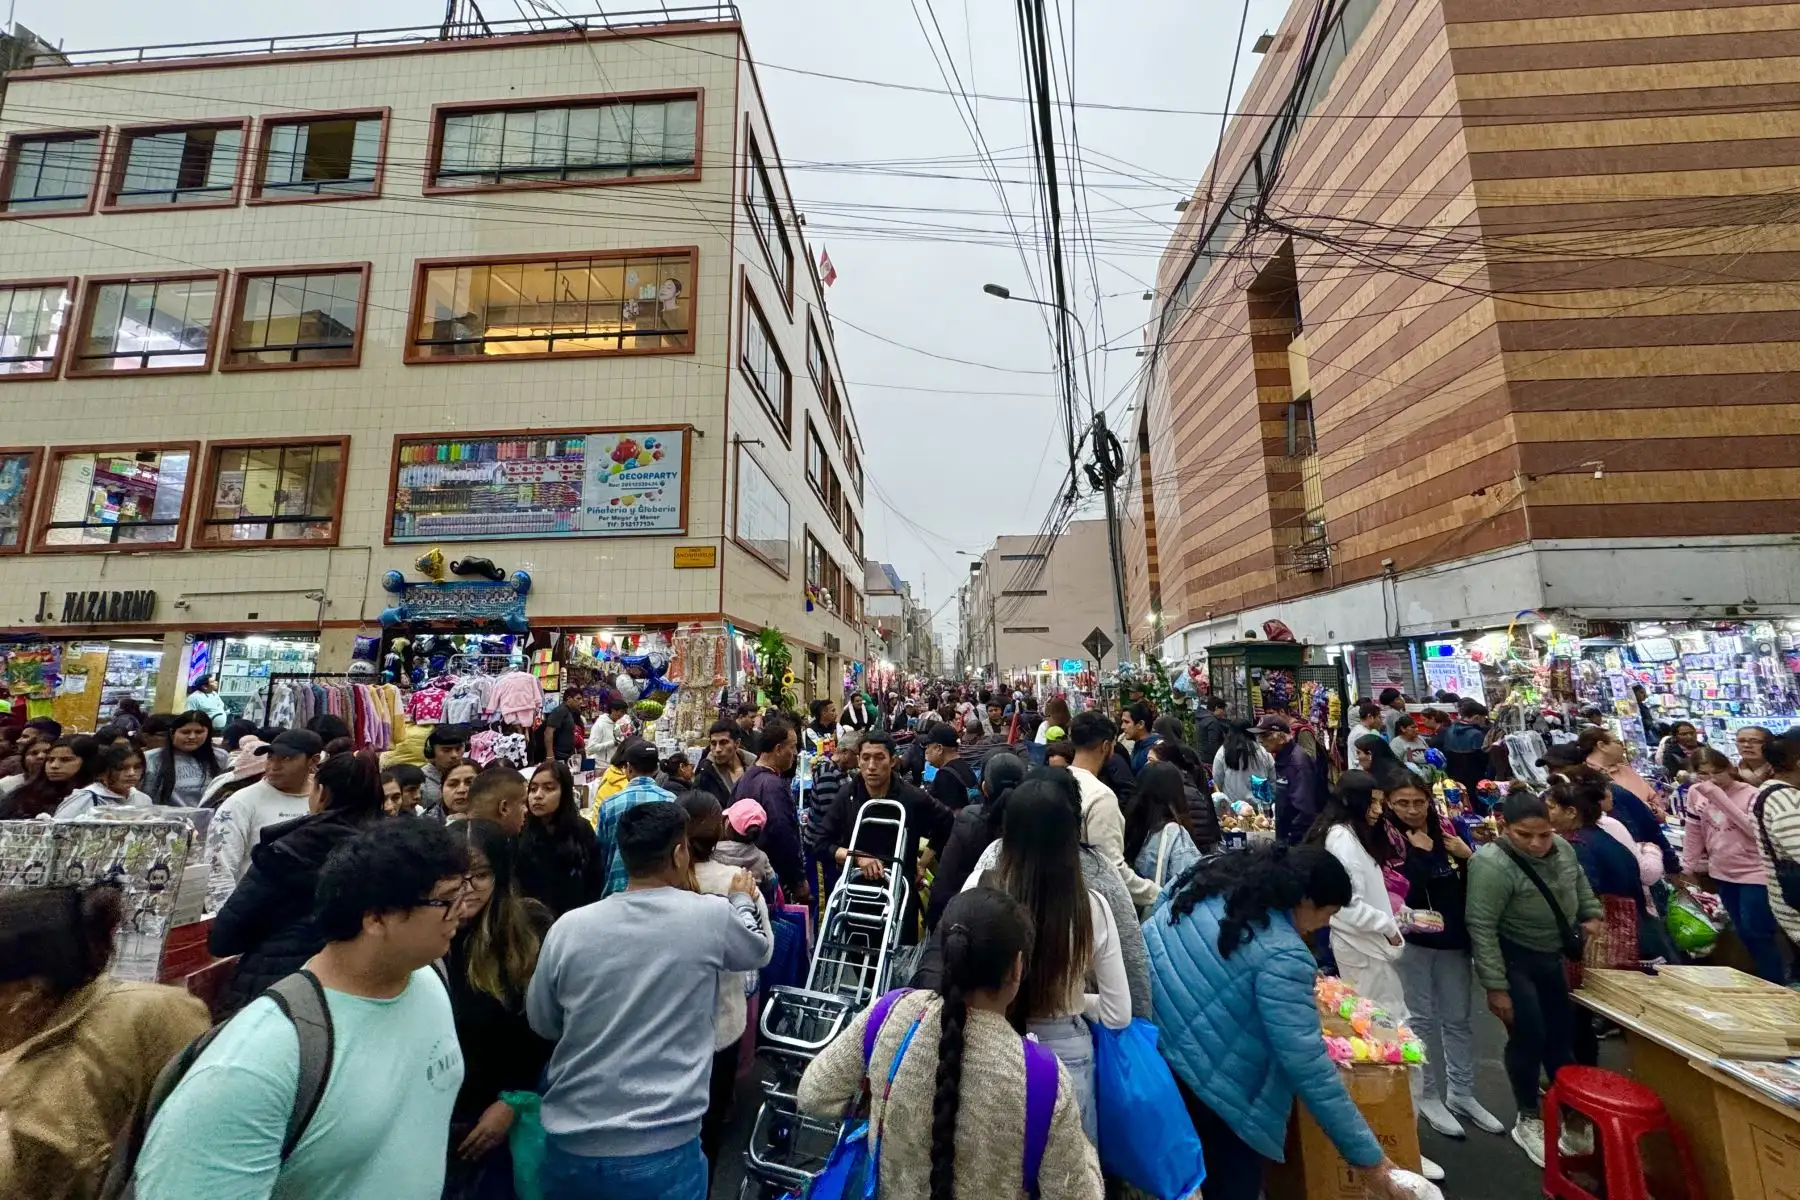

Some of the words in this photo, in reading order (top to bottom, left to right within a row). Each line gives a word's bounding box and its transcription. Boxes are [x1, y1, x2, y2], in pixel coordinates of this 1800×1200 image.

[619, 471, 678, 480] DECORPARTY
[629, 508, 636, 516] y
[35, 591, 54, 622] J.
[60, 590, 156, 622] NAZARENO
[185, 633, 194, 643] S
